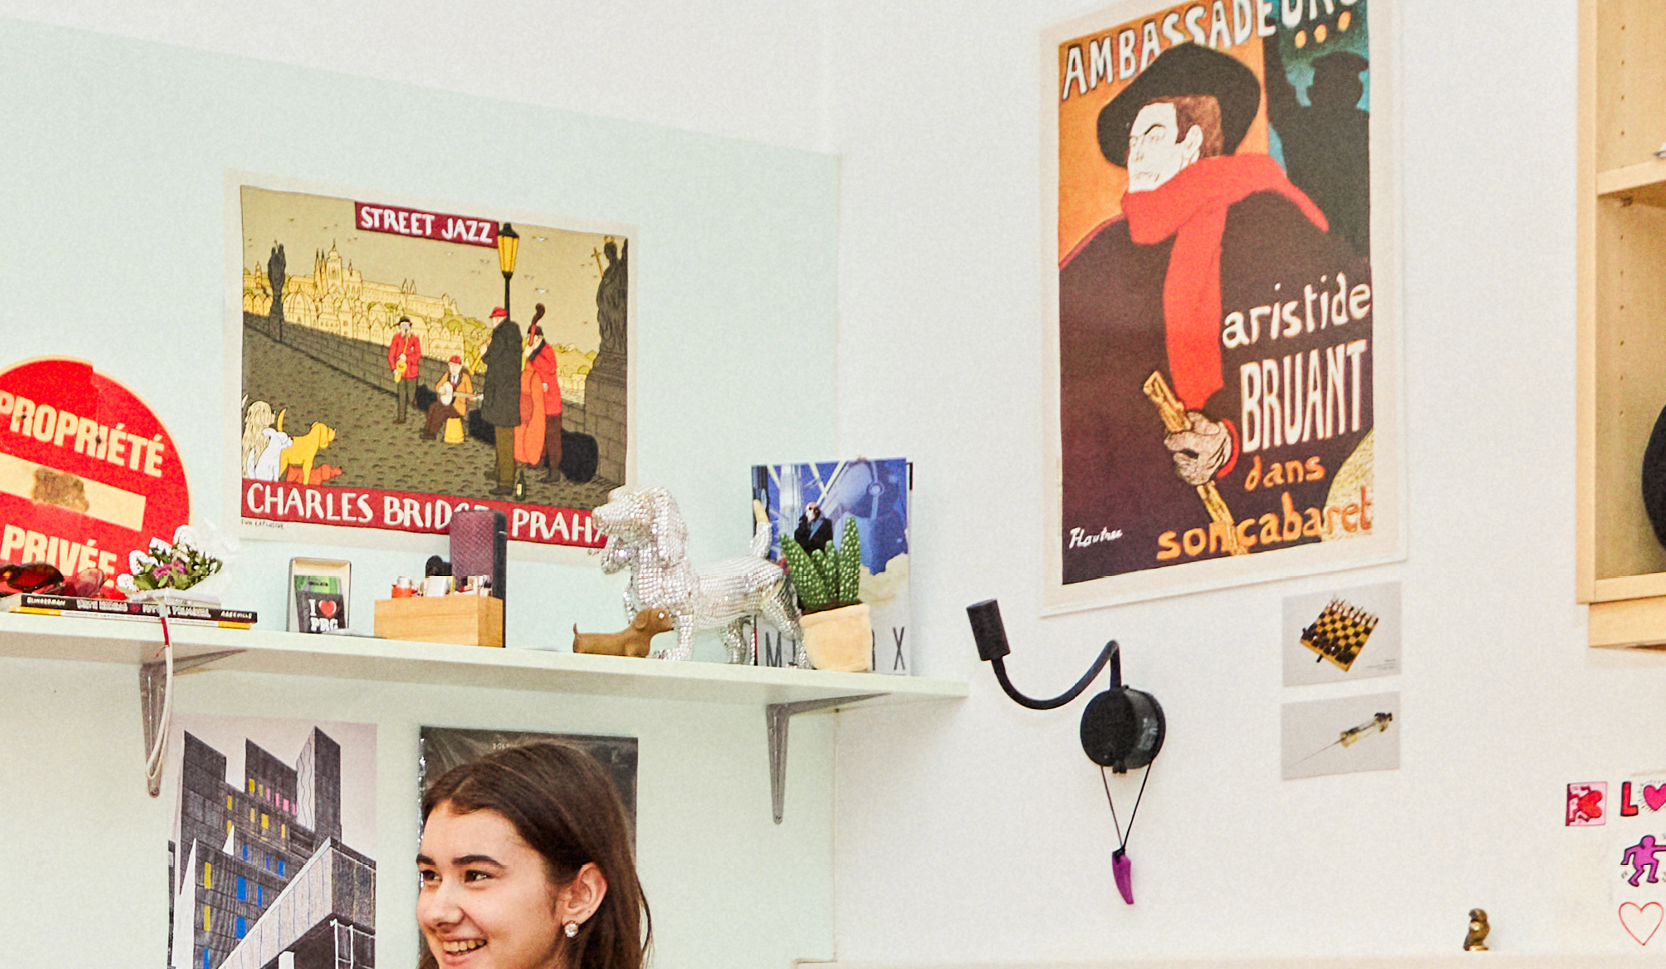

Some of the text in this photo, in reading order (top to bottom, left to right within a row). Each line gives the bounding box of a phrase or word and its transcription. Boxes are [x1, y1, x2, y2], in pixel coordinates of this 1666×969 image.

[1062, 0, 1359, 100] AMBASSADEU
[360, 206, 493, 243] STREET JAZZ
[1221, 271, 1372, 350] aristide
[1239, 338, 1368, 454] BRUANT
[1244, 455, 1325, 492] dans
[246, 481, 603, 544] CHARLES BRID PRAH
[308, 598, 318, 616] I
